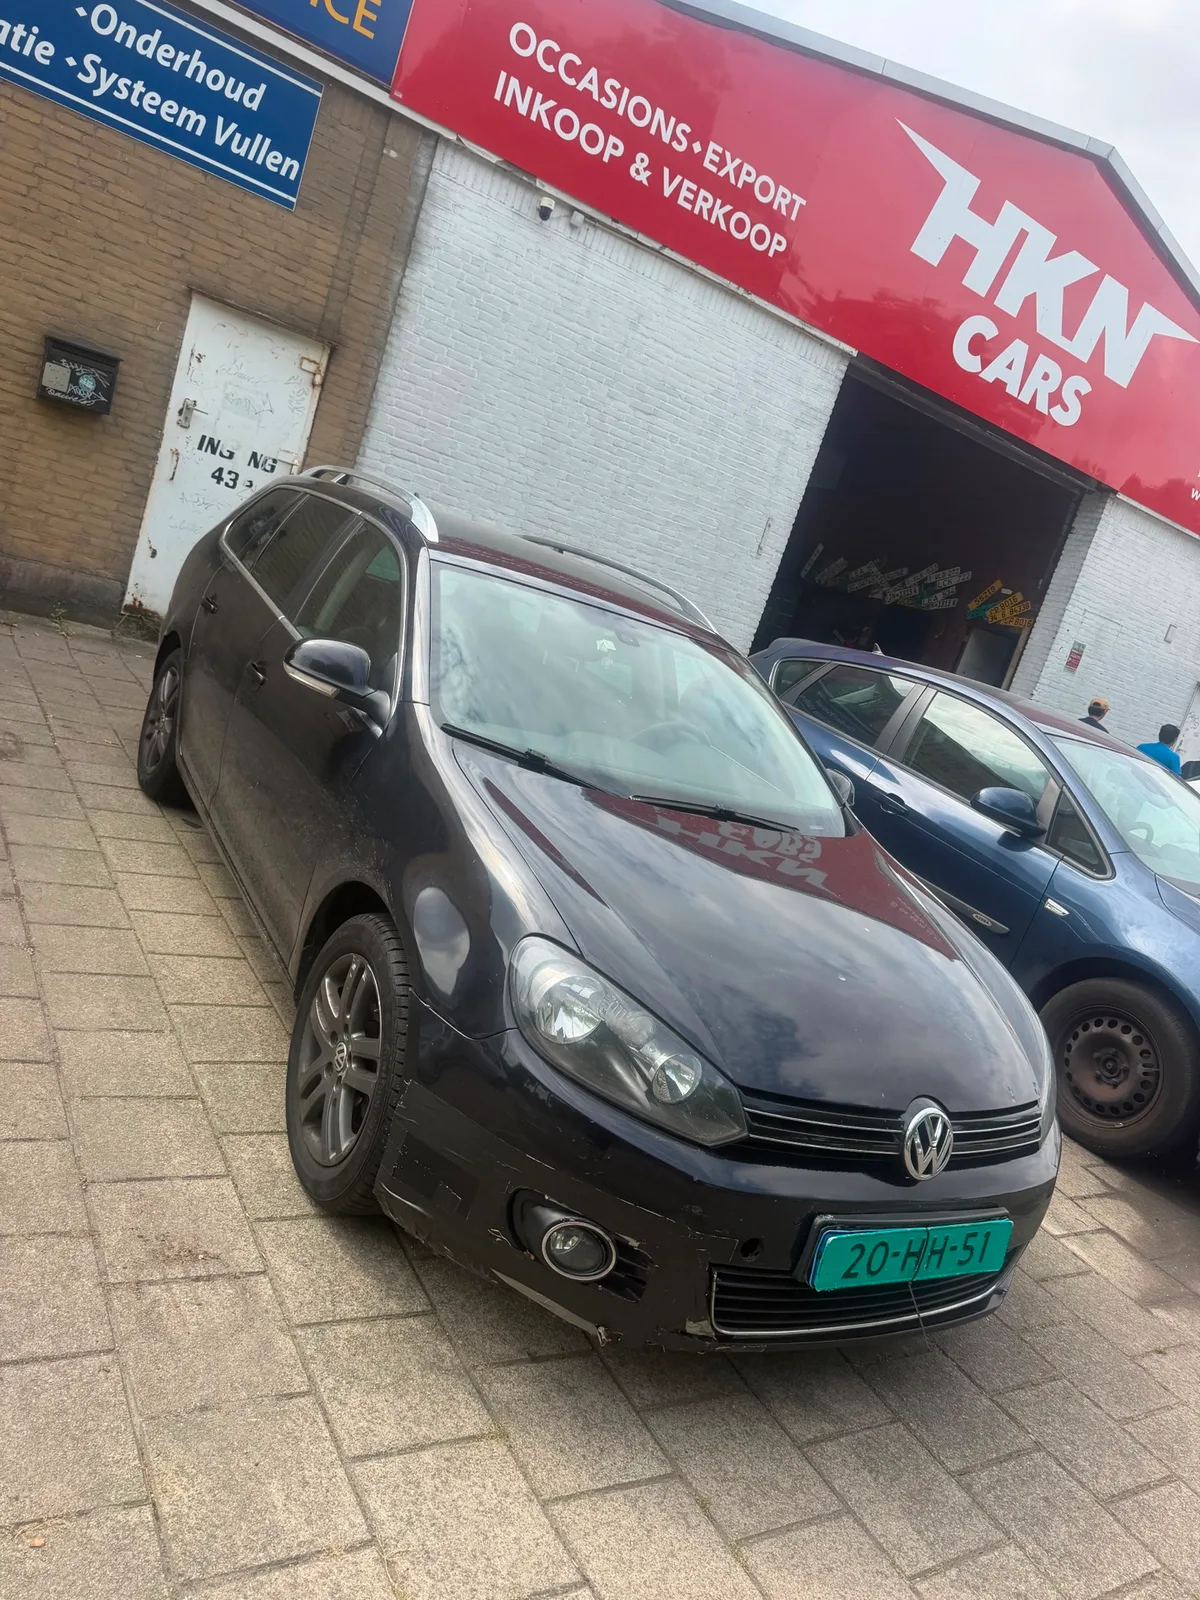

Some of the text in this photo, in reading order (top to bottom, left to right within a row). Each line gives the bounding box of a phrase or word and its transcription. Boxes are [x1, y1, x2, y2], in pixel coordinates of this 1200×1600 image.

[77, 53, 206, 137] Systeem
[213, 115, 300, 181] Vullen
[90, 4, 267, 111] Onderhoud
[493, 70, 787, 258] INKOOP & VERKOOP
[509, 22, 807, 222] OCCASIONS EXPORT
[894, 116, 1200, 389] HKN
[952, 315, 1093, 426] CARS
[840, 1230, 992, 1280] 20-HH-51
